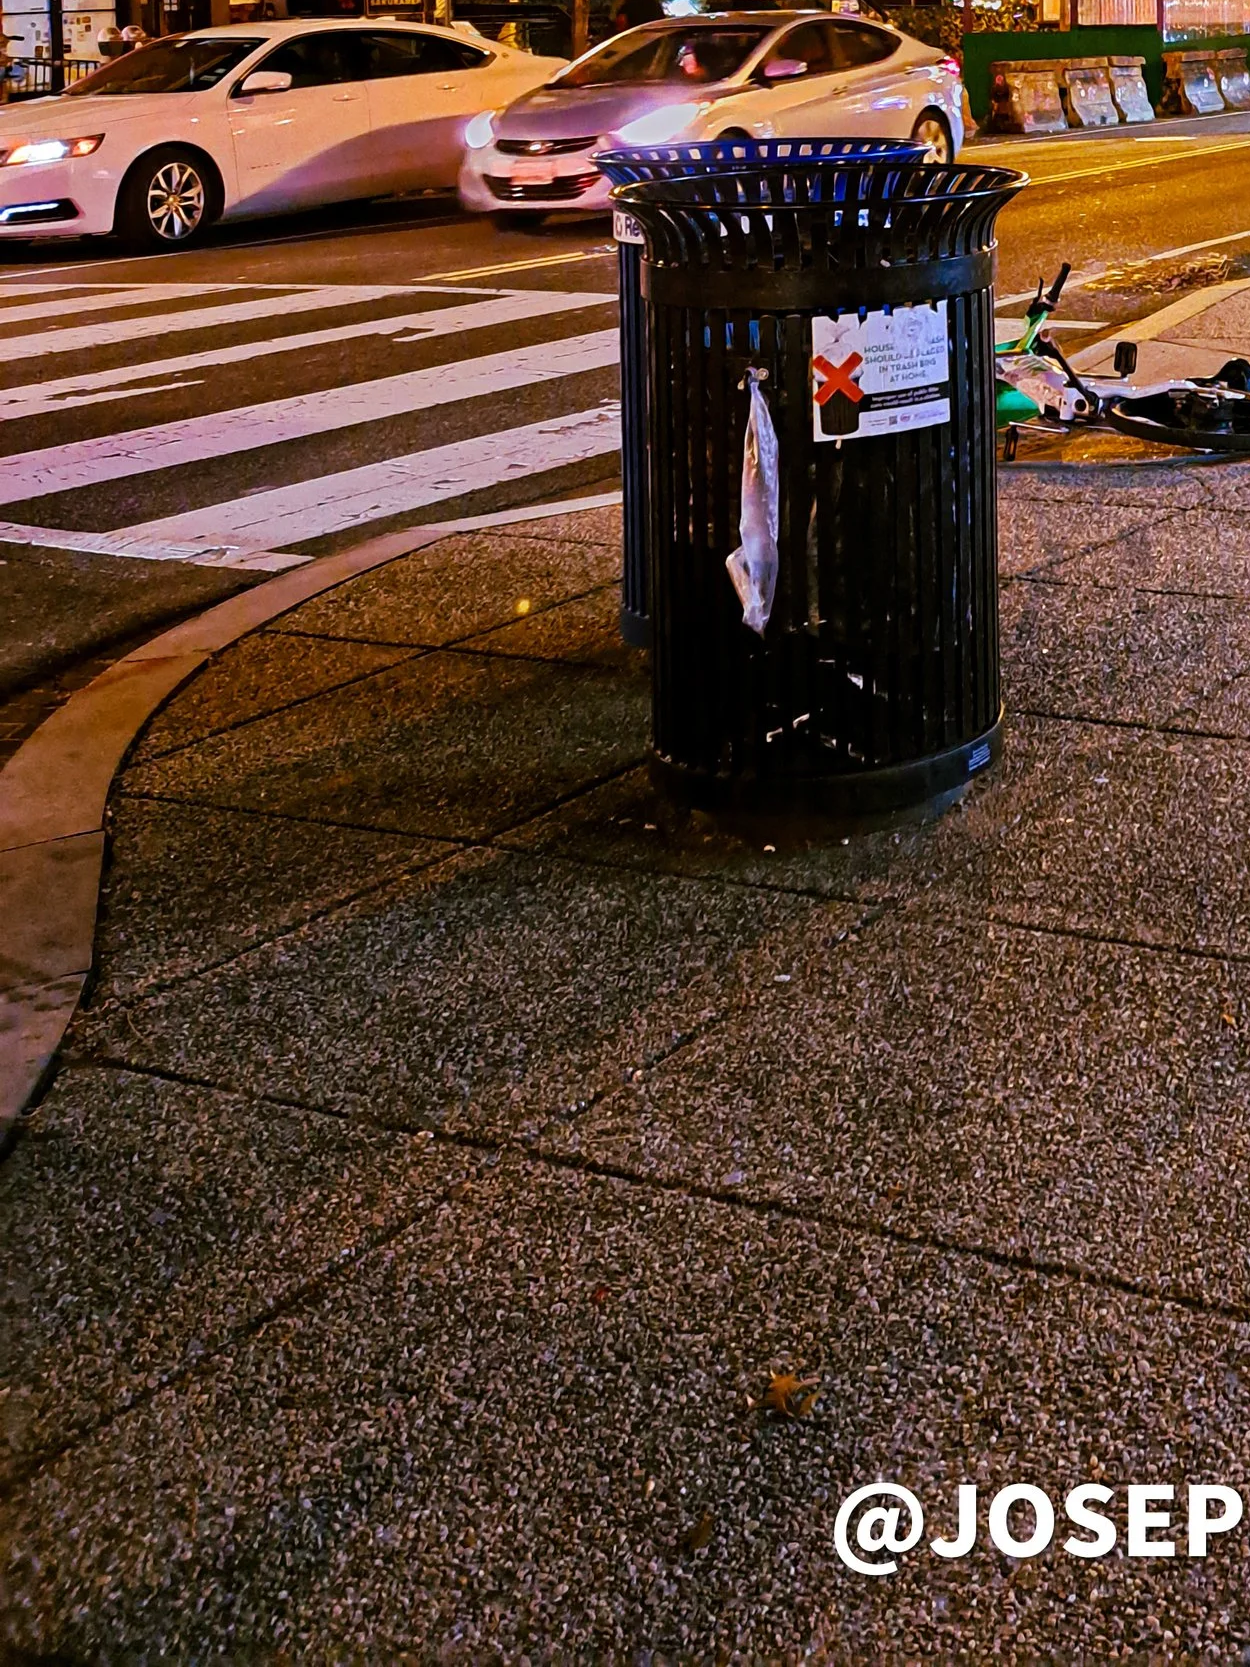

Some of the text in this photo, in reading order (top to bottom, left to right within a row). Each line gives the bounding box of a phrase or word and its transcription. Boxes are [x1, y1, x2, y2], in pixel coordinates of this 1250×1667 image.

[864, 353, 902, 365] SHOULD
[879, 365, 888, 374] IN
[890, 361, 918, 372] TRASH
[890, 374, 900, 383] AT
